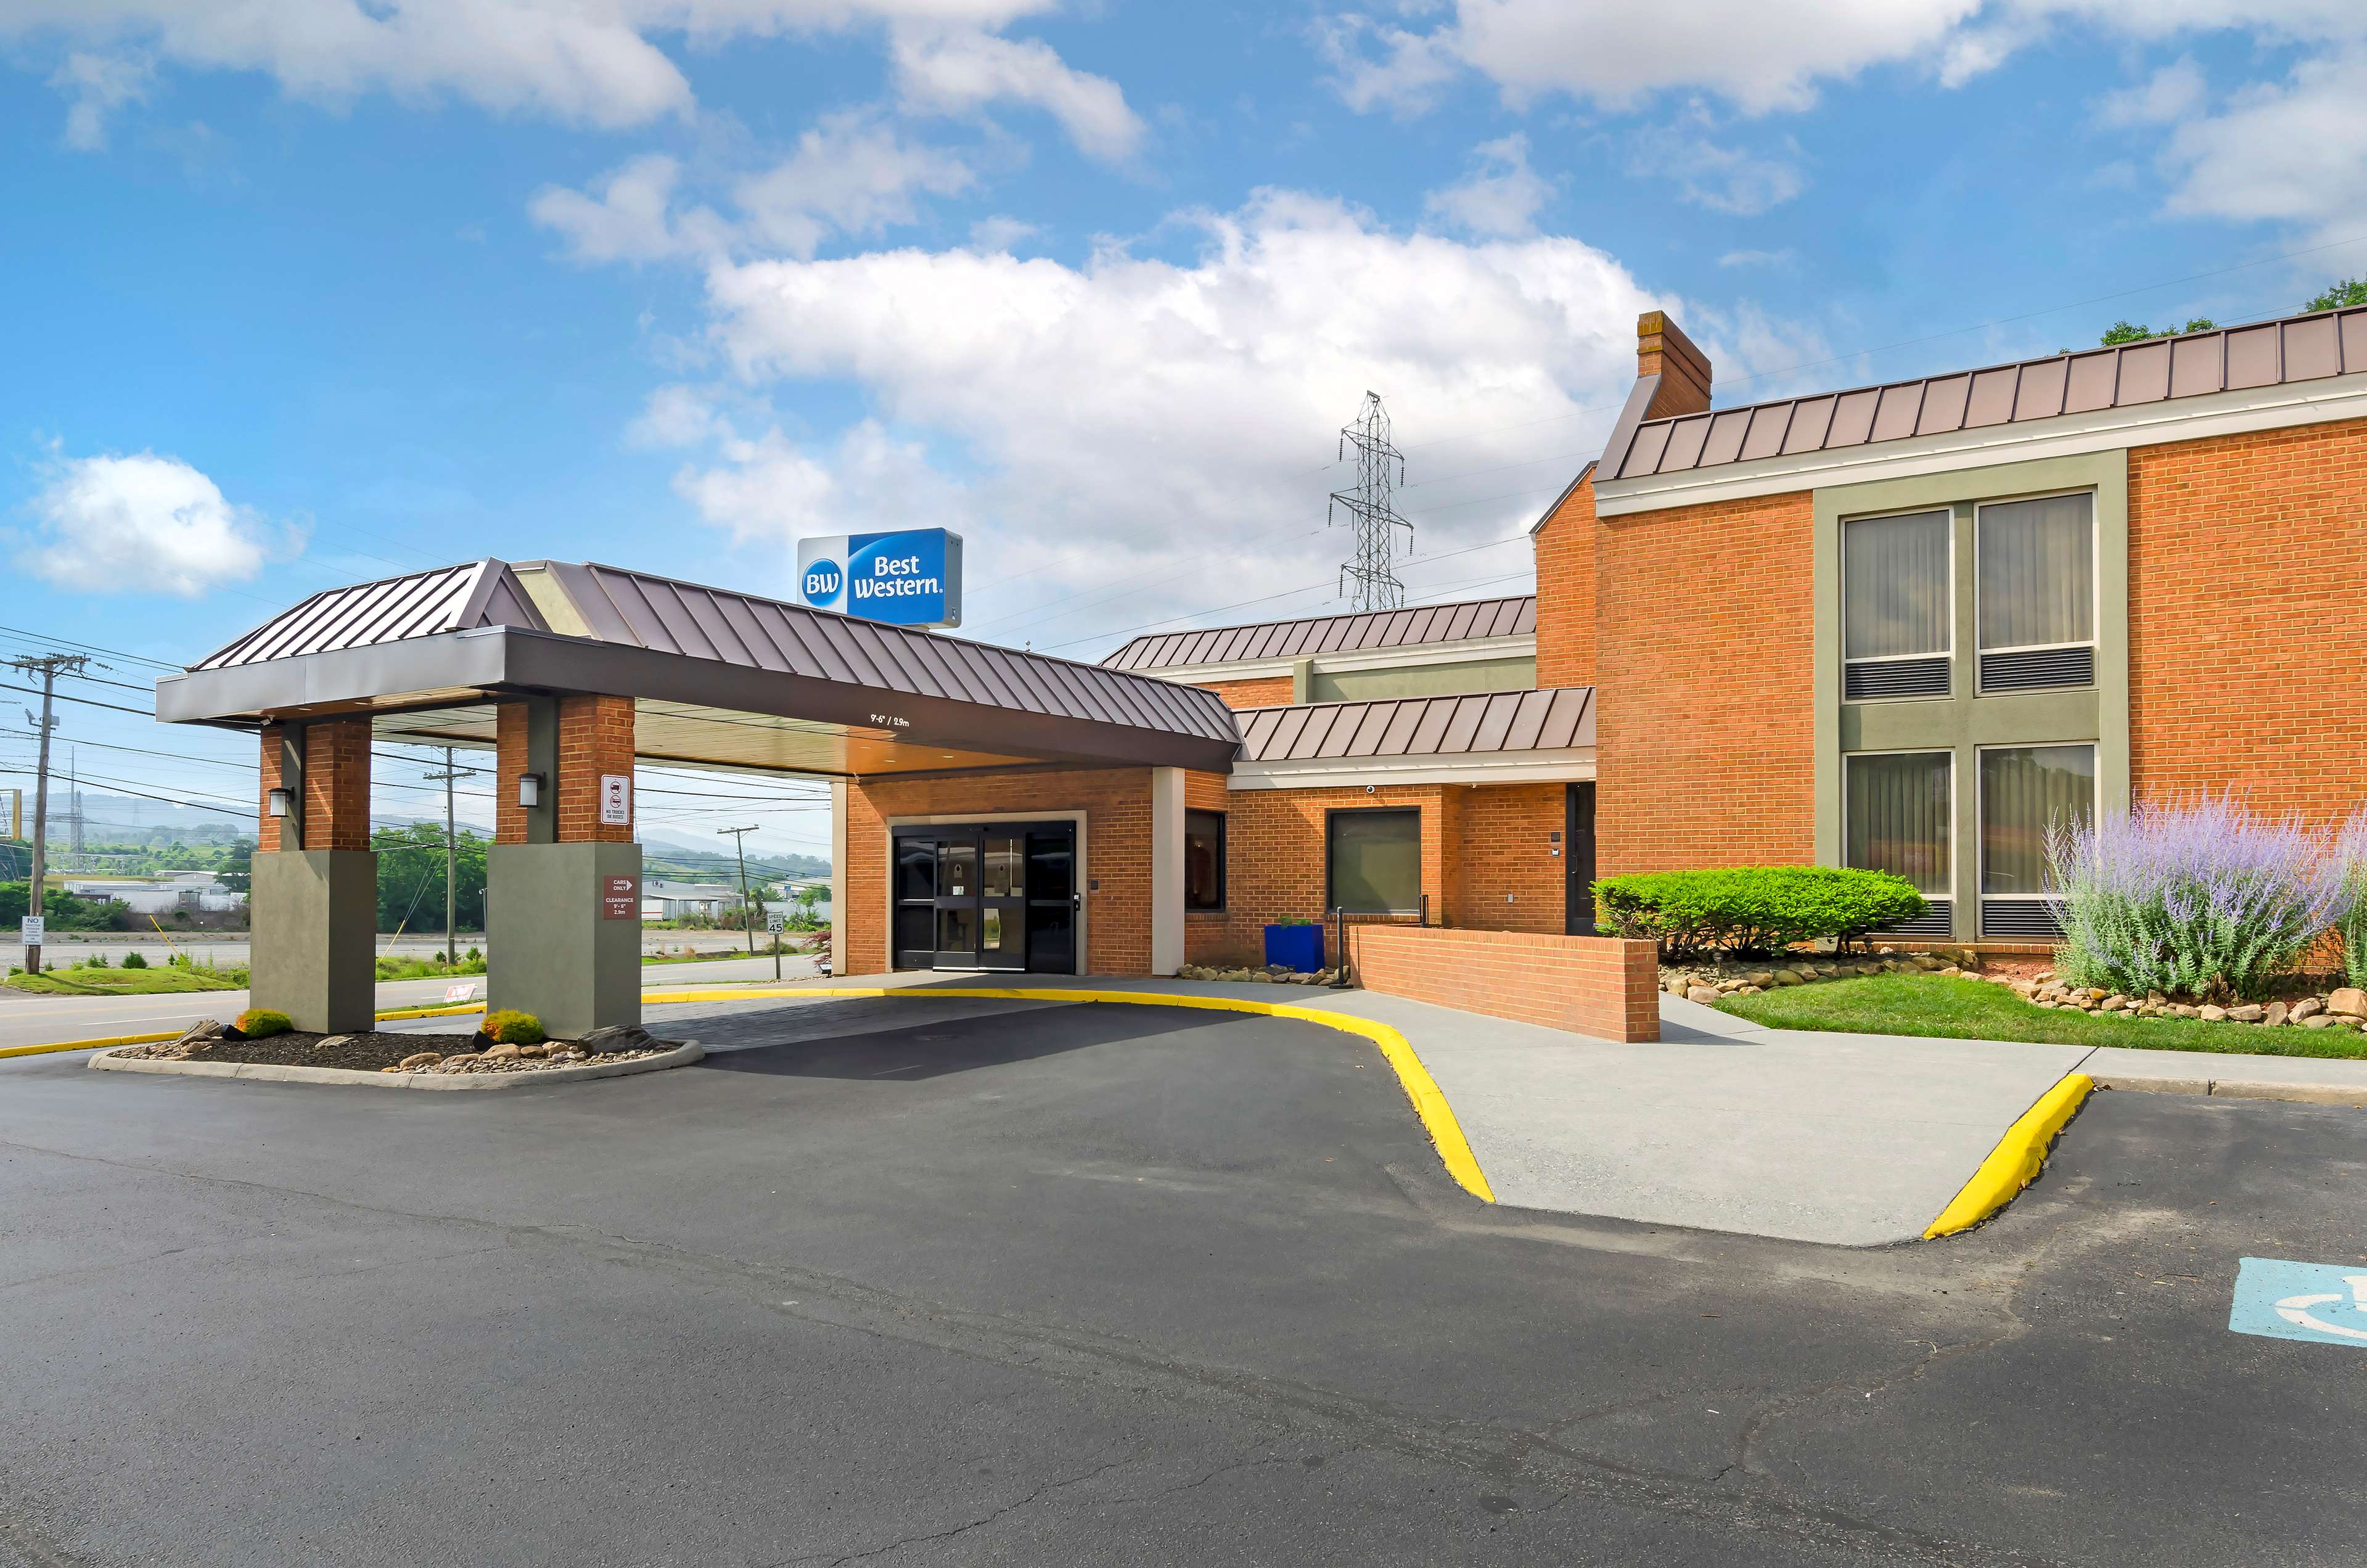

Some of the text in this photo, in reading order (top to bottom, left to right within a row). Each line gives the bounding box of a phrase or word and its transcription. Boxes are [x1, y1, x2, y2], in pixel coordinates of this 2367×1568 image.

[875, 556, 919, 577] Best
[806, 573, 839, 594] BW
[769, 924, 782, 932] 45
